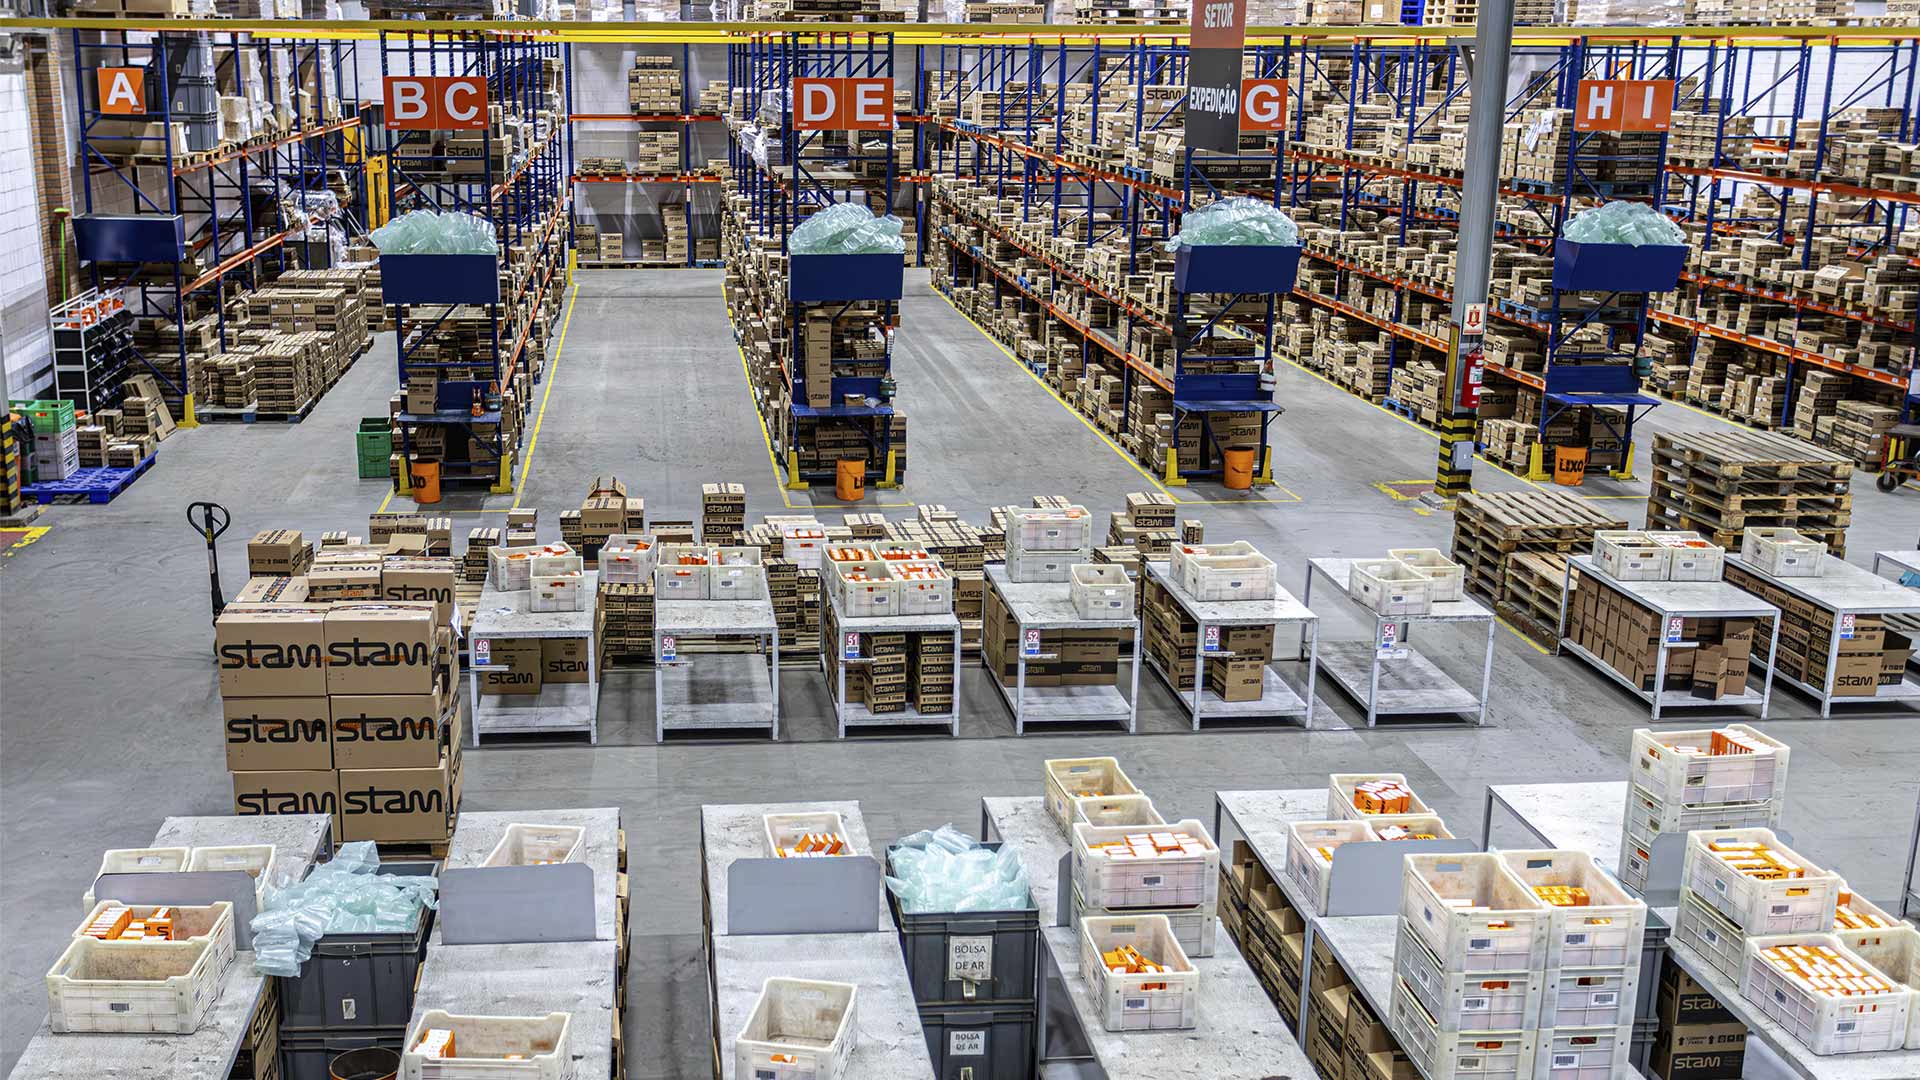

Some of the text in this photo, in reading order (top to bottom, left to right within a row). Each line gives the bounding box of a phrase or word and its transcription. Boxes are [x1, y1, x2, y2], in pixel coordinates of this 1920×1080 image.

[992, 7, 1017, 15] stam
[1018, 6, 1043, 14] stam
[1204, 2, 1234, 28] SETOR
[107, 72, 139, 106] A
[1146, 88, 1181, 100] stam
[392, 81, 428, 120] B
[444, 81, 479, 121] C
[803, 84, 836, 121] D
[856, 84, 885, 121] E
[1189, 83, 1237, 120] EXPEDIÇÃO
[1245, 84, 1280, 122] G
[1588, 86, 1613, 119] H
[1643, 86, 1654, 119] I
[446, 145, 483, 157] stam
[1669, 371, 1687, 381] sta
[1180, 420, 1199, 430] tam
[1231, 427, 1256, 436] stam
[1179, 439, 1197, 447] tam
[1178, 457, 1197, 465] tam
[1560, 458, 1584, 473] LIXO
[412, 474, 426, 488] XO
[854, 476, 865, 489] LI
[707, 505, 732, 513] stam
[1136, 518, 1162, 527] stam
[372, 526, 397, 535] stam
[401, 525, 425, 534] stam
[314, 564, 378, 573] stam
[341, 589, 364, 597] stam
[387, 584, 451, 604] stam
[1671, 619, 1682, 630] 55
[1843, 615, 1854, 626] 56
[1027, 631, 1038, 642] 52
[1207, 627, 1218, 638] 53
[1384, 625, 1395, 637] 54
[663, 638, 674, 649] 50
[847, 634, 859, 646] 51
[327, 637, 428, 667] stam
[477, 641, 489, 653] 49
[922, 645, 943, 653] stam
[1180, 648, 1195, 657] sta
[221, 639, 322, 669] stam
[873, 665, 893, 674] stam
[922, 665, 943, 673] stam
[1727, 668, 1744, 677] tam
[488, 672, 533, 684] stam
[1180, 677, 1195, 685] sta
[1838, 675, 1872, 686] stam
[876, 685, 896, 693] stam
[922, 685, 943, 693] stam
[875, 704, 896, 712] stam
[922, 704, 943, 712] stam
[227, 714, 327, 744] stam
[335, 713, 435, 743] stam
[237, 788, 336, 815] stam
[344, 786, 442, 815] stam
[955, 945, 986, 954] BOLSA
[955, 961, 984, 970] DE AR
[1675, 1056, 1720, 1069] stam
